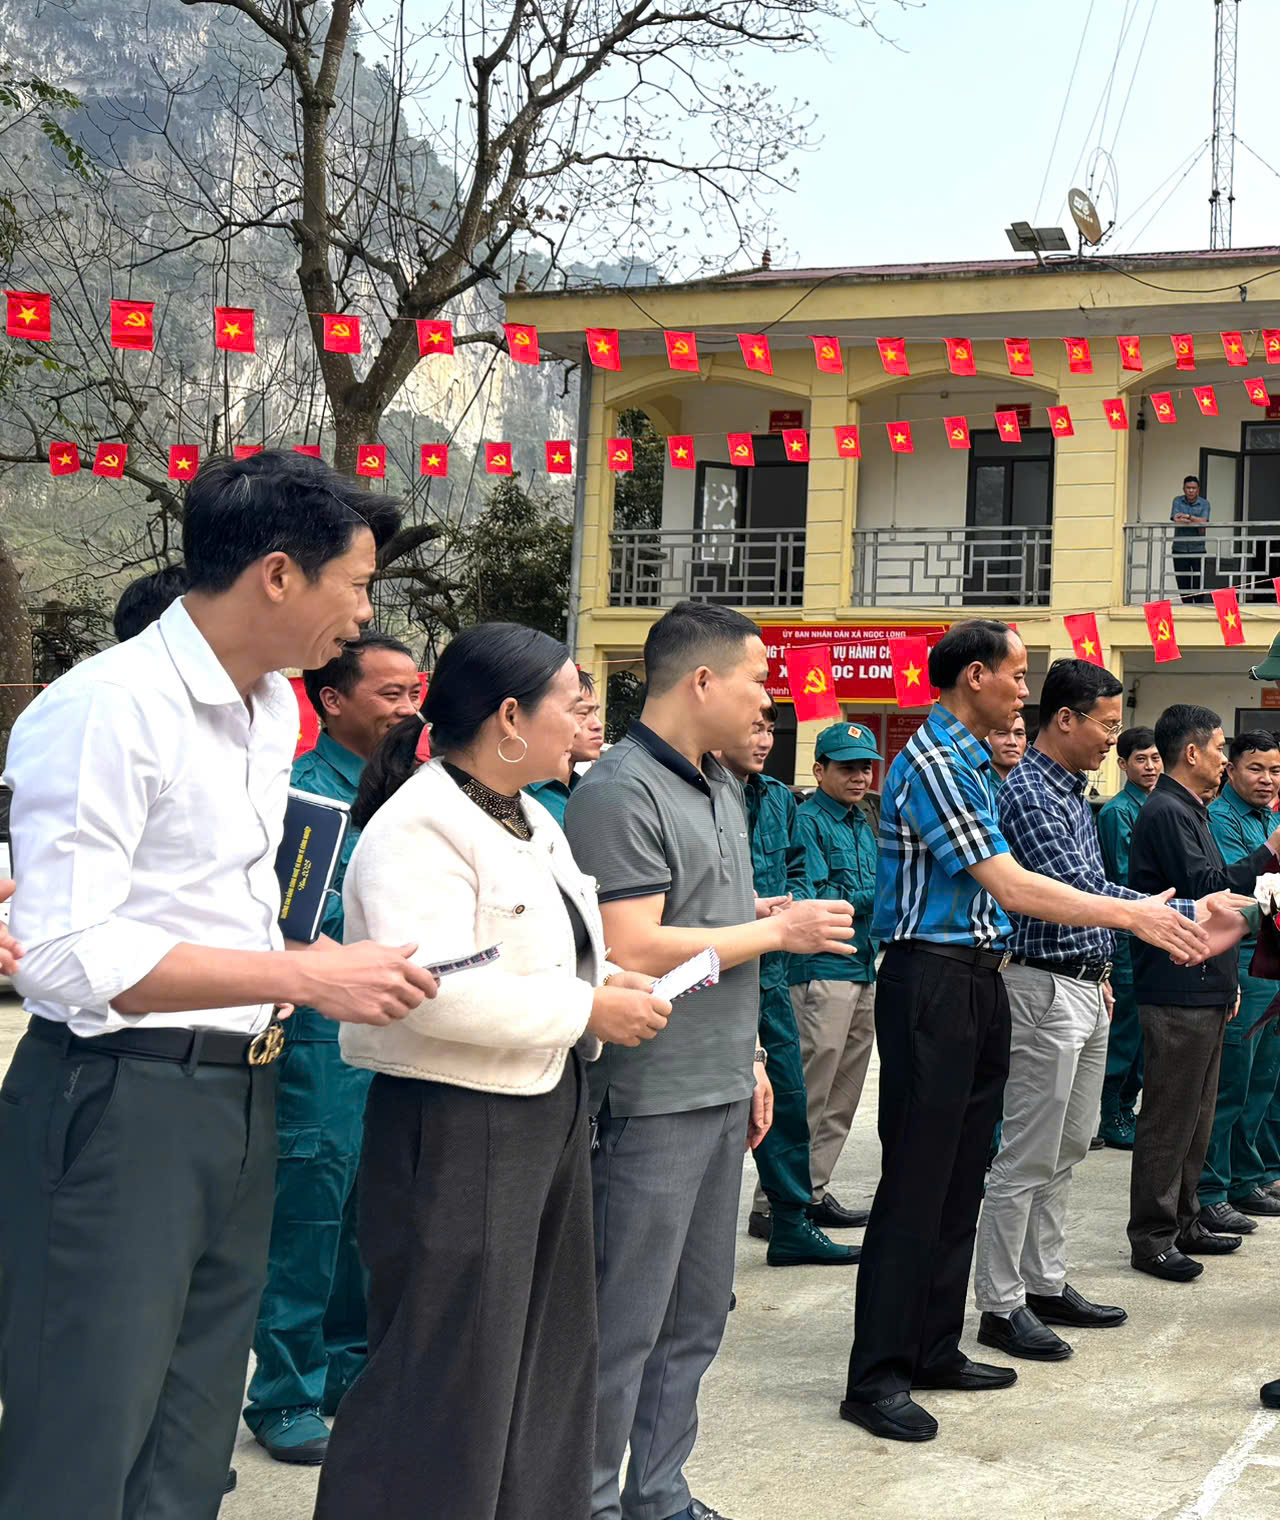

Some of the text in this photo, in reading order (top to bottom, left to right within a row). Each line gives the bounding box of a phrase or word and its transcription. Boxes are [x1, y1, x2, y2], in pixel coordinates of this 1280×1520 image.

[833, 645, 845, 662] VỤ
[849, 644, 877, 659] HÀNH
[832, 665, 854, 681] ỌC
[859, 665, 892, 679] LON
